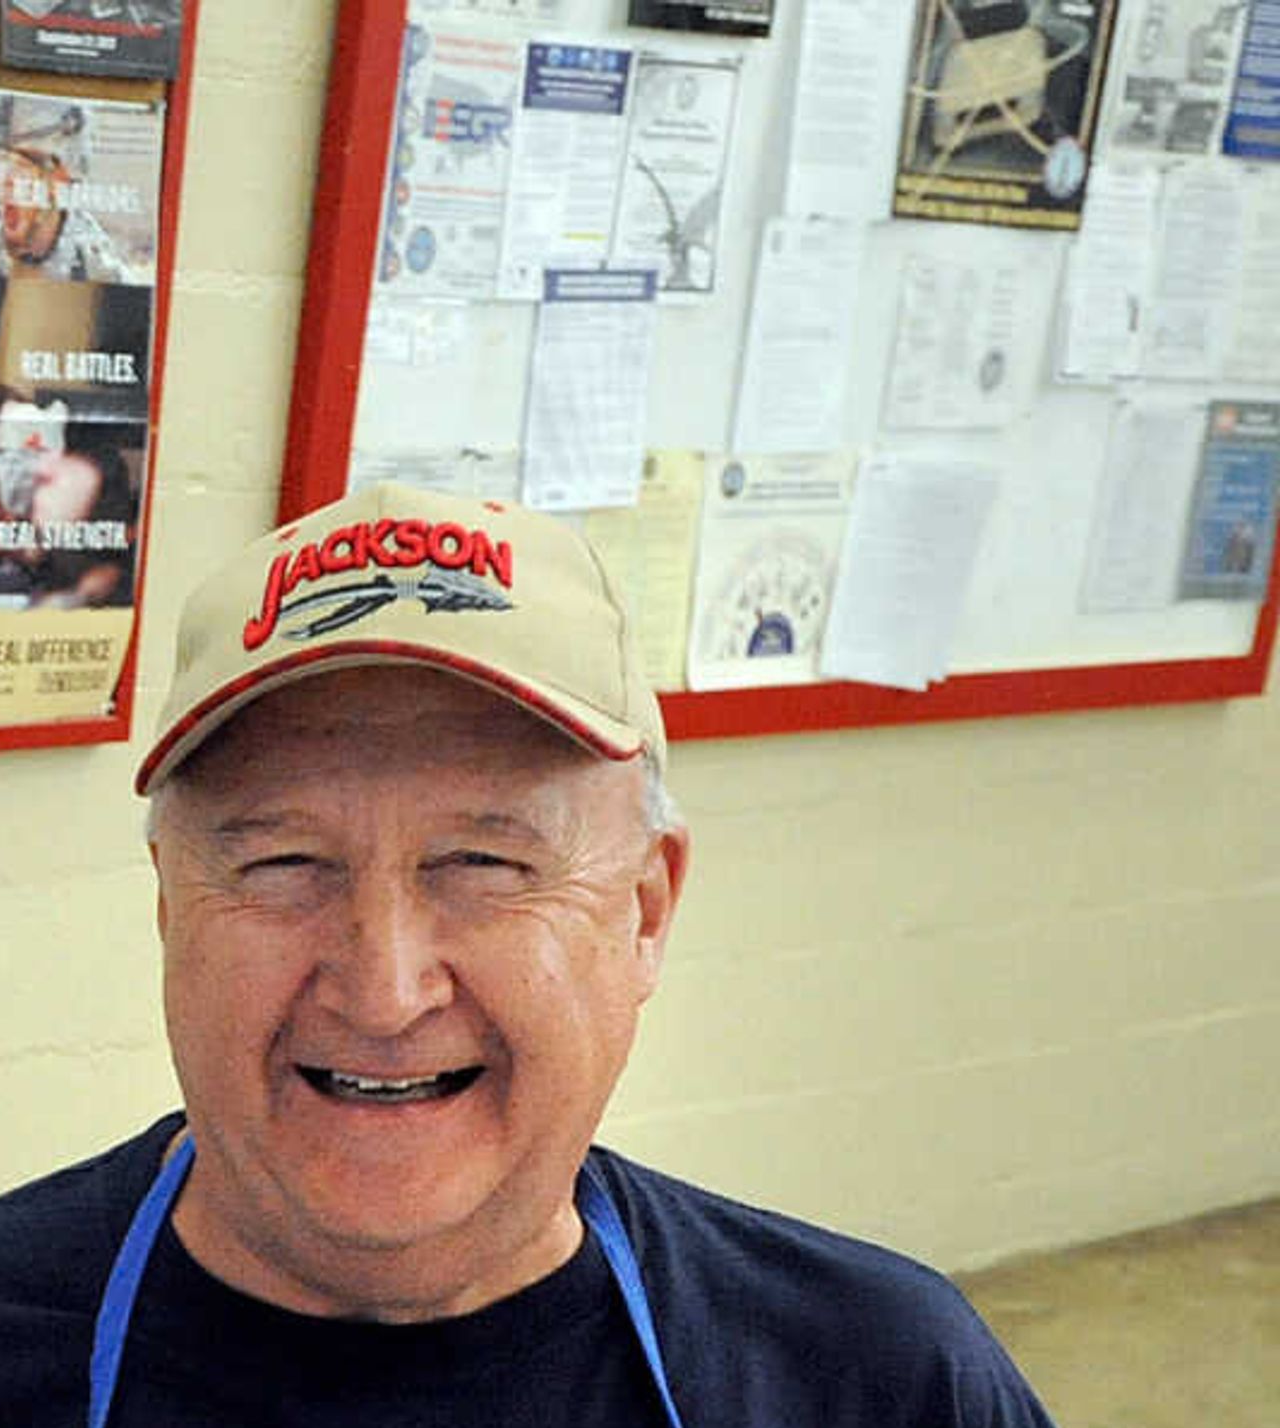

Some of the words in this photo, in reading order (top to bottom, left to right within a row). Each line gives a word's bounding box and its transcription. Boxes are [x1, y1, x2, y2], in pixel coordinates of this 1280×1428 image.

[13, 177, 52, 209] REAL
[21, 350, 61, 380] REAL
[65, 351, 139, 383] BATTLES.
[242, 517, 513, 651] JACKSON
[27, 637, 113, 664] DIFFERENCE
